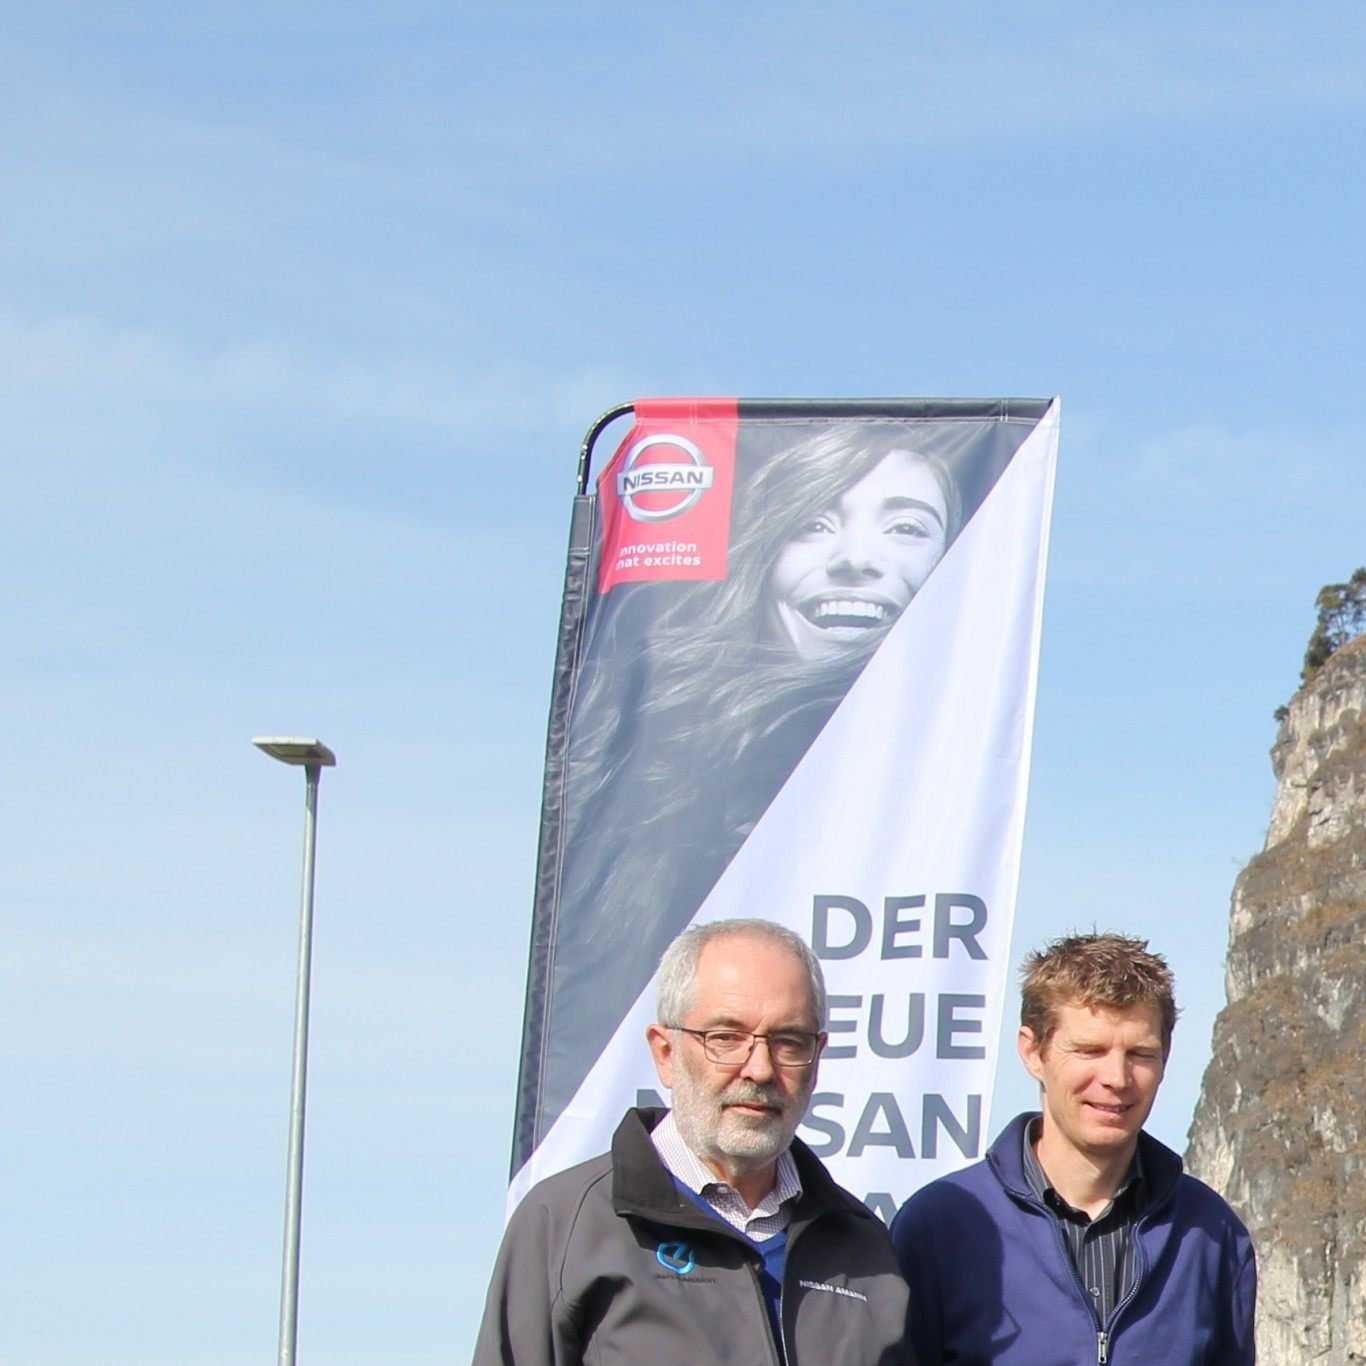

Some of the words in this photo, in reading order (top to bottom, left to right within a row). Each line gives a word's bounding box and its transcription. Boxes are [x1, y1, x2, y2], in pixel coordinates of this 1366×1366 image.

[623, 471, 704, 491] NISSAN
[620, 541, 697, 557] nnovation
[644, 554, 701, 567] excites
[812, 893, 988, 961] DER
[822, 992, 986, 1061] EUE
